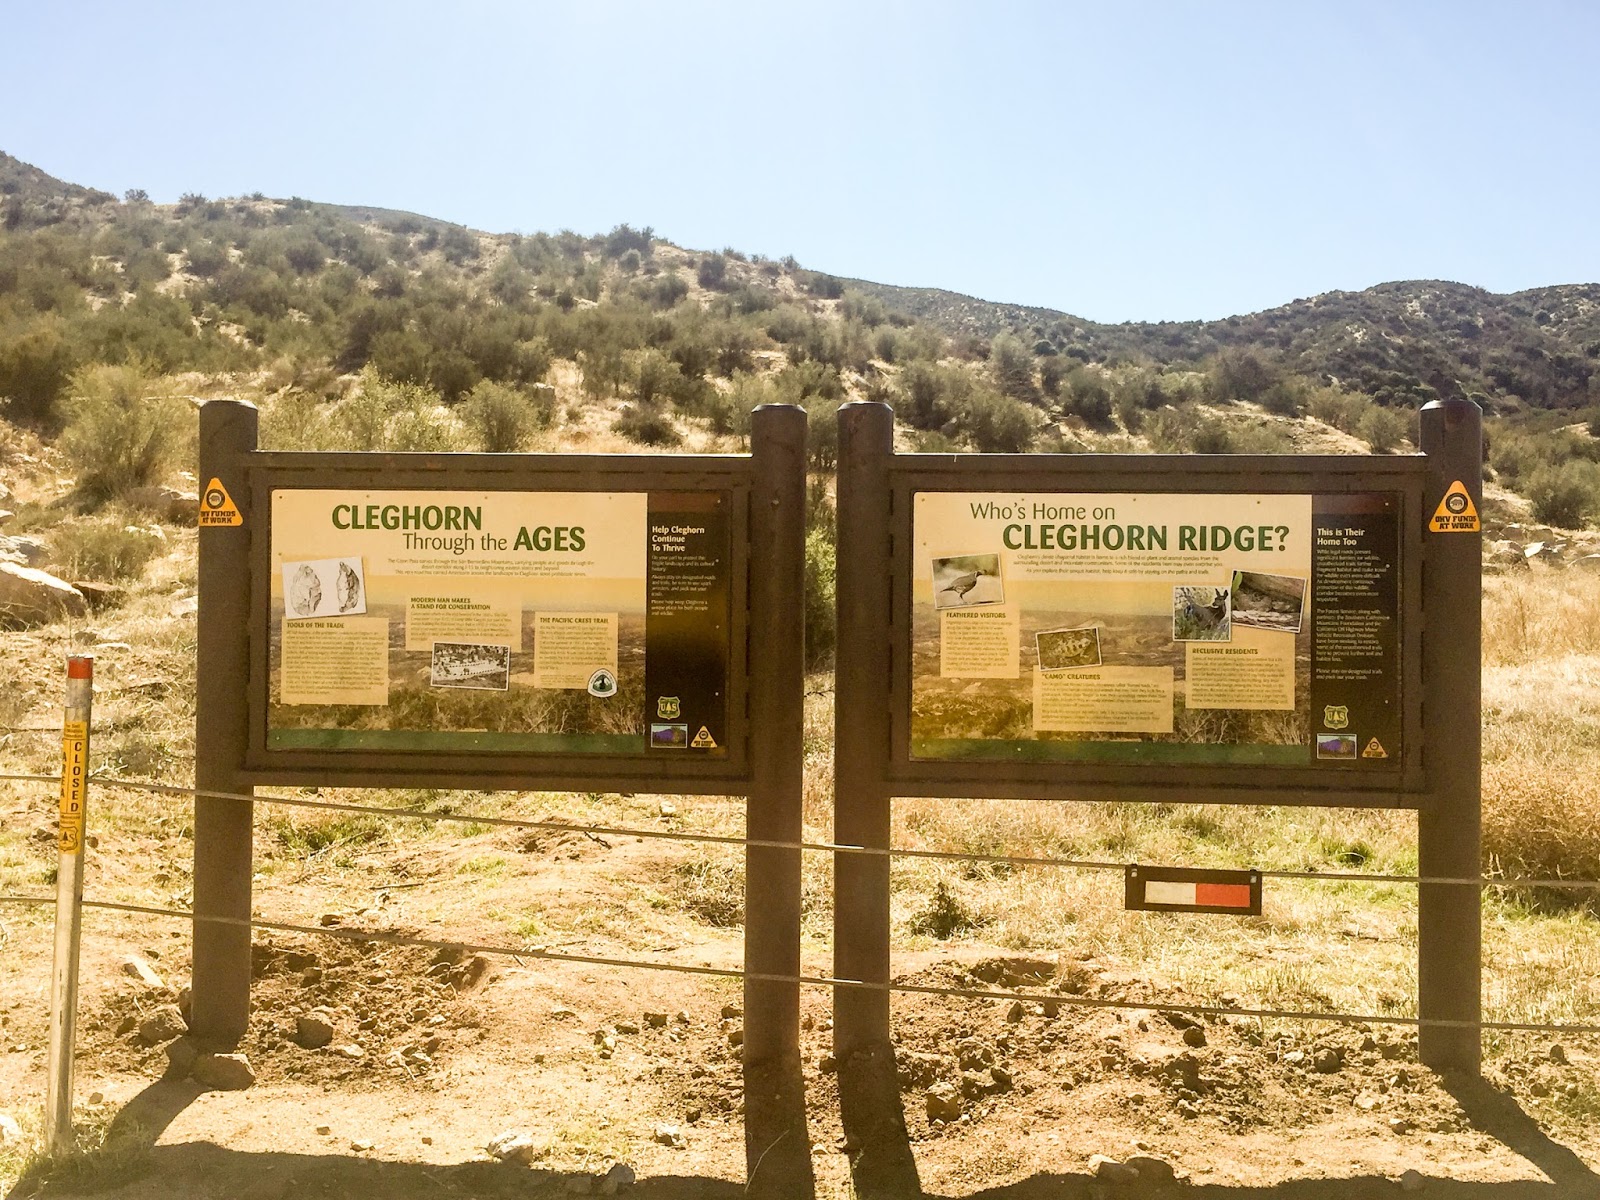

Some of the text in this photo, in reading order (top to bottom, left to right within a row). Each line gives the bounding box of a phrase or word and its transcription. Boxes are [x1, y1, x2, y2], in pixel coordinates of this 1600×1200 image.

[332, 504, 482, 530] CLEGHORN
[970, 502, 1115, 520] Who's Home on
[652, 526, 705, 535] Help Cleghorn
[1317, 528, 1333, 536] This
[1344, 528, 1365, 536] Their
[402, 526, 586, 555] Through the AGES
[652, 535, 686, 543] Continue
[1003, 524, 1290, 552] CLEGHORN RIDGE?
[1317, 538, 1357, 546] Home Too
[652, 544, 686, 552] To Thrive
[71, 741, 82, 812] CLOSED
